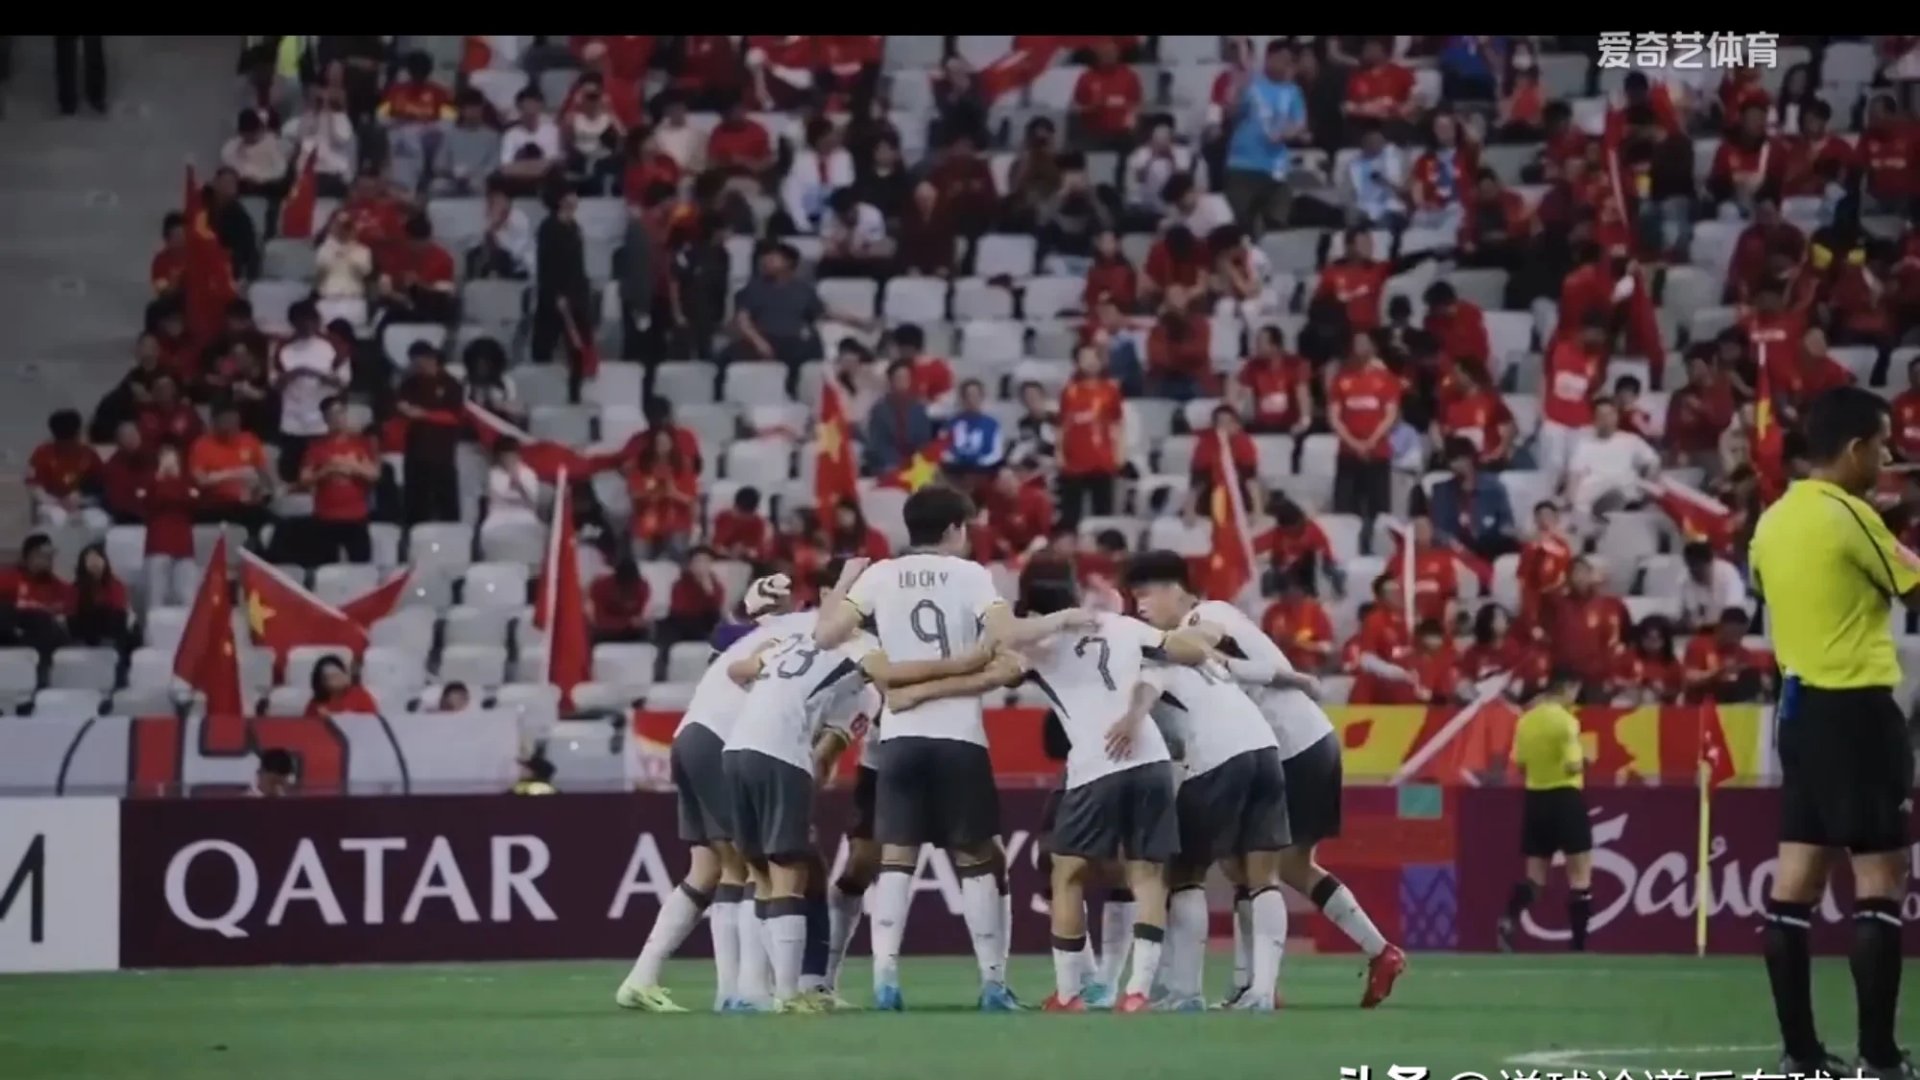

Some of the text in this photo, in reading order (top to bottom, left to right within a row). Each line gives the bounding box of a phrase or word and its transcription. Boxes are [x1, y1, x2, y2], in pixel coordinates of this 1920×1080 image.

[910, 599, 951, 659] 9
[1073, 636, 1117, 692] 7
[164, 834, 558, 938] QATAR
